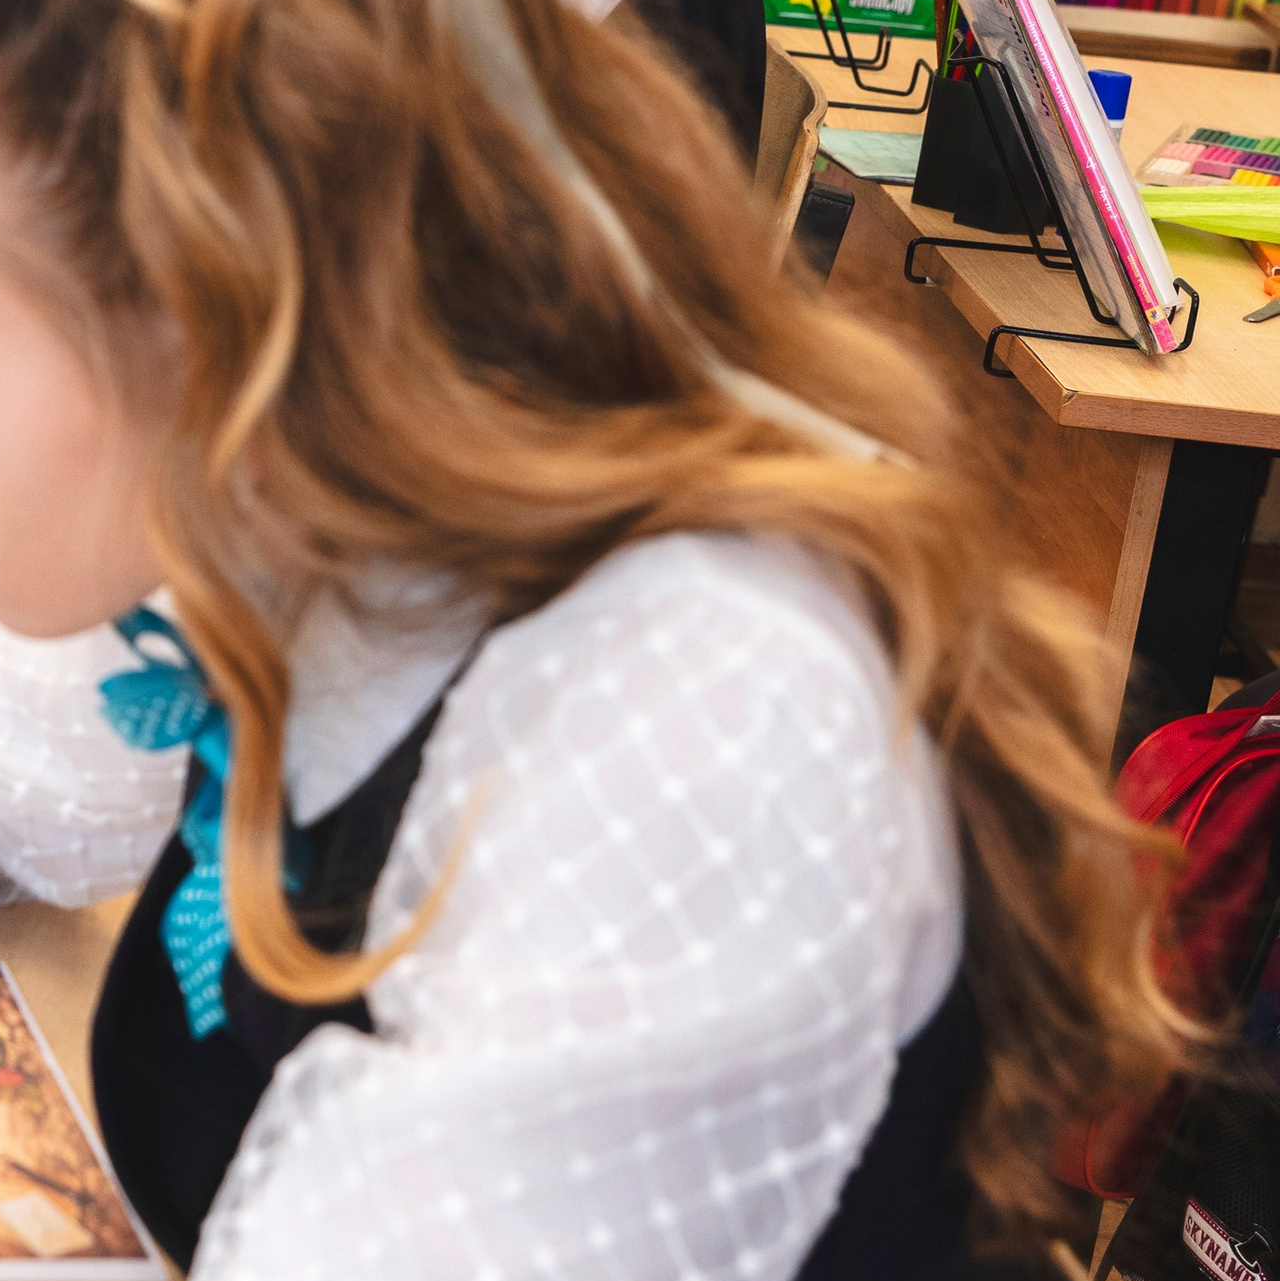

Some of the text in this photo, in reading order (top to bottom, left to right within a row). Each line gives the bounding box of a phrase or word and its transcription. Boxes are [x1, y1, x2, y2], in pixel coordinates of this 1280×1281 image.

[1028, 21, 1072, 116] Литературное чтение
[1099, 185, 1114, 213] Часть
[1126, 253, 1152, 304] Школа России
